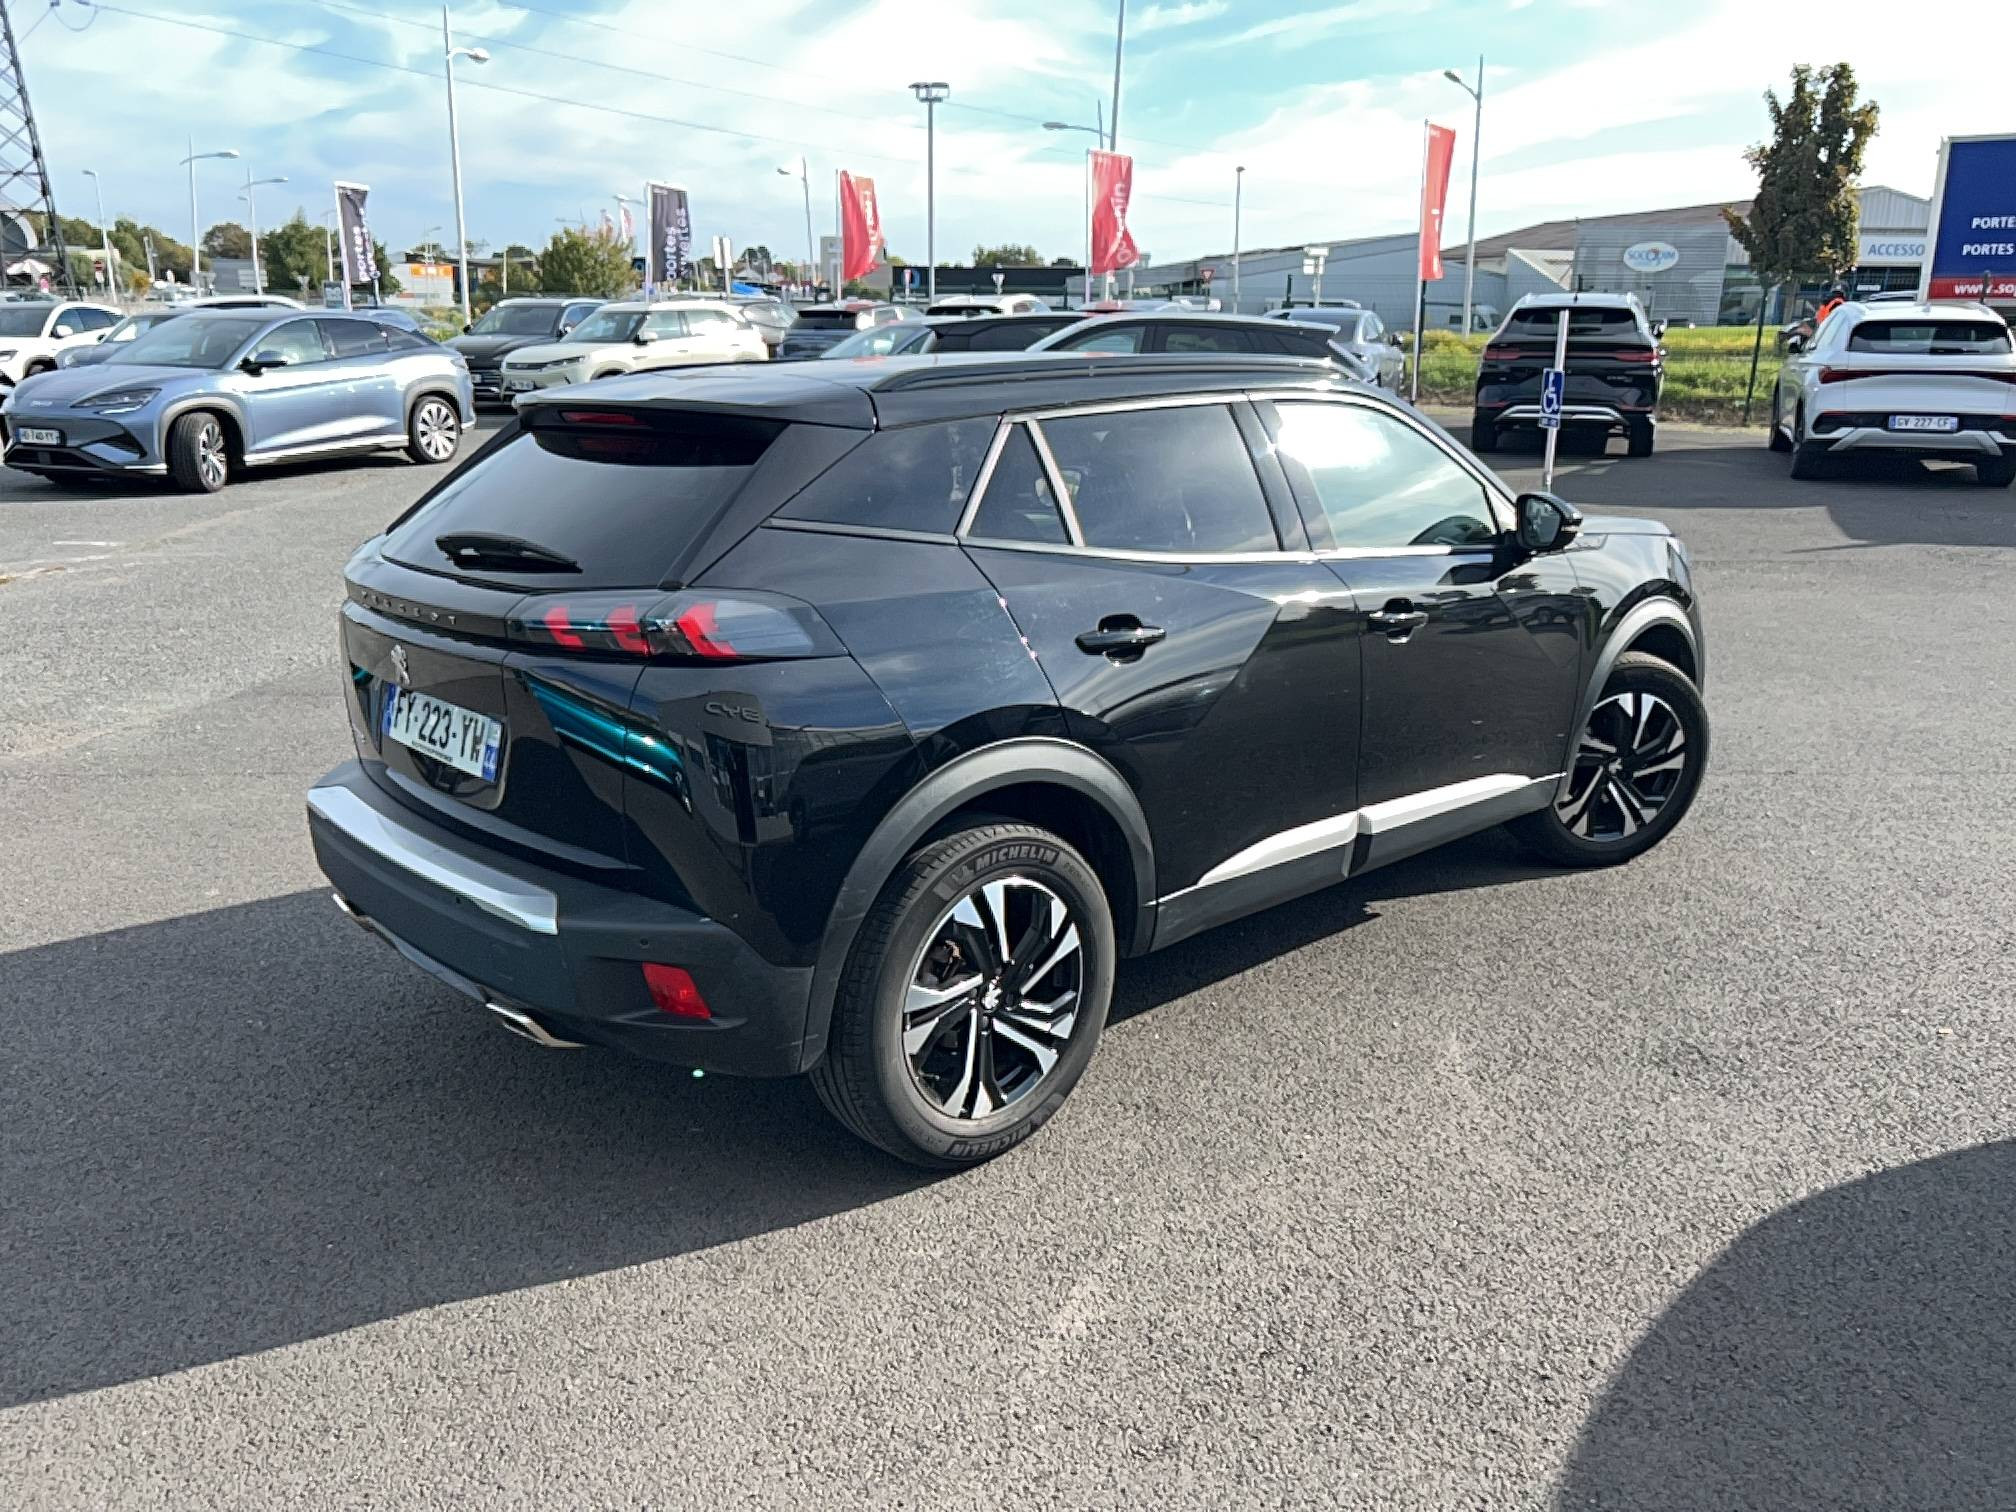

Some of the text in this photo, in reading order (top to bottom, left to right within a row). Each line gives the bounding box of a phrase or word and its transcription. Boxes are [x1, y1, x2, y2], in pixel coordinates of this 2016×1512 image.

[1868, 244, 1926, 257] ACCESSO
[1962, 243, 2014, 256] PORTES
[975, 845, 1058, 873] MICHELIN
